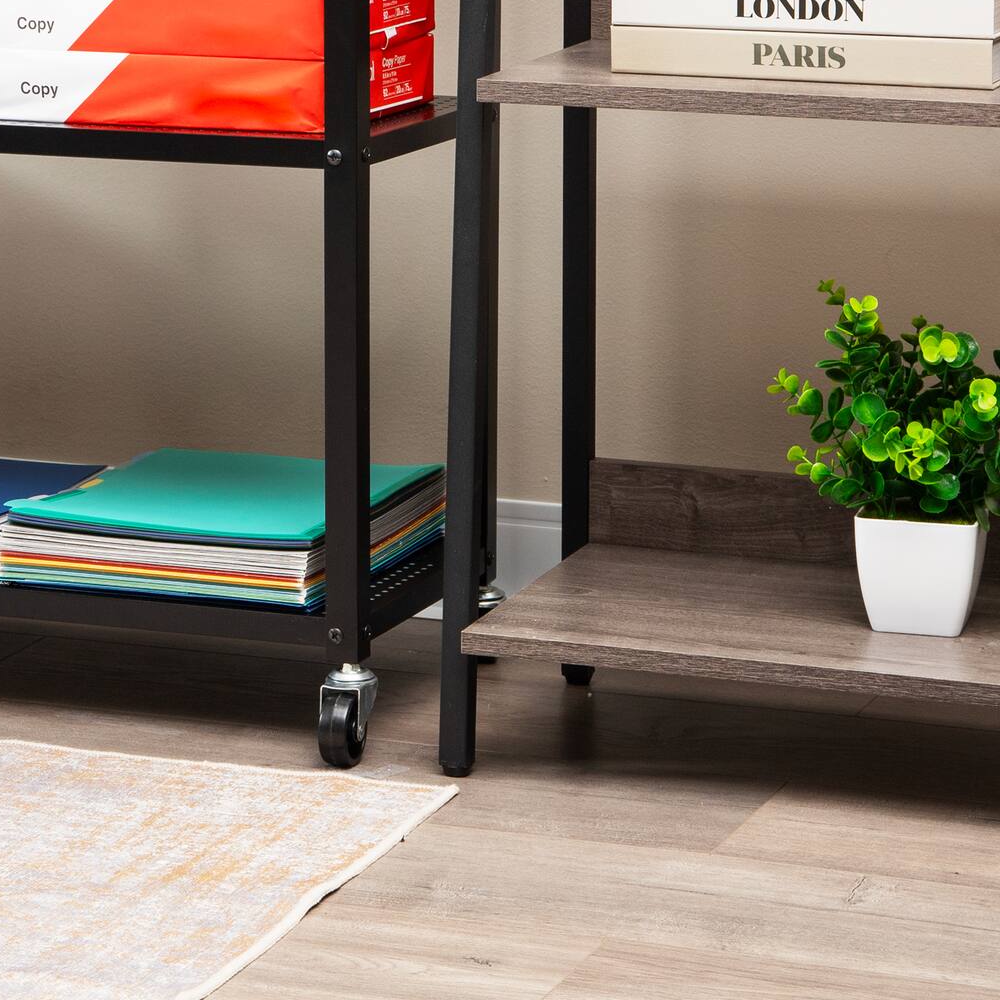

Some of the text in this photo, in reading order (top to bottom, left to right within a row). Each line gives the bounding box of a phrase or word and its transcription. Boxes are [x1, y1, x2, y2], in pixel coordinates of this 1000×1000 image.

[17, 16, 55, 34] Copy
[382, 55, 406, 68] Copy Paper
[752, 42, 846, 70] PARIS
[20, 81, 59, 99] Copy
